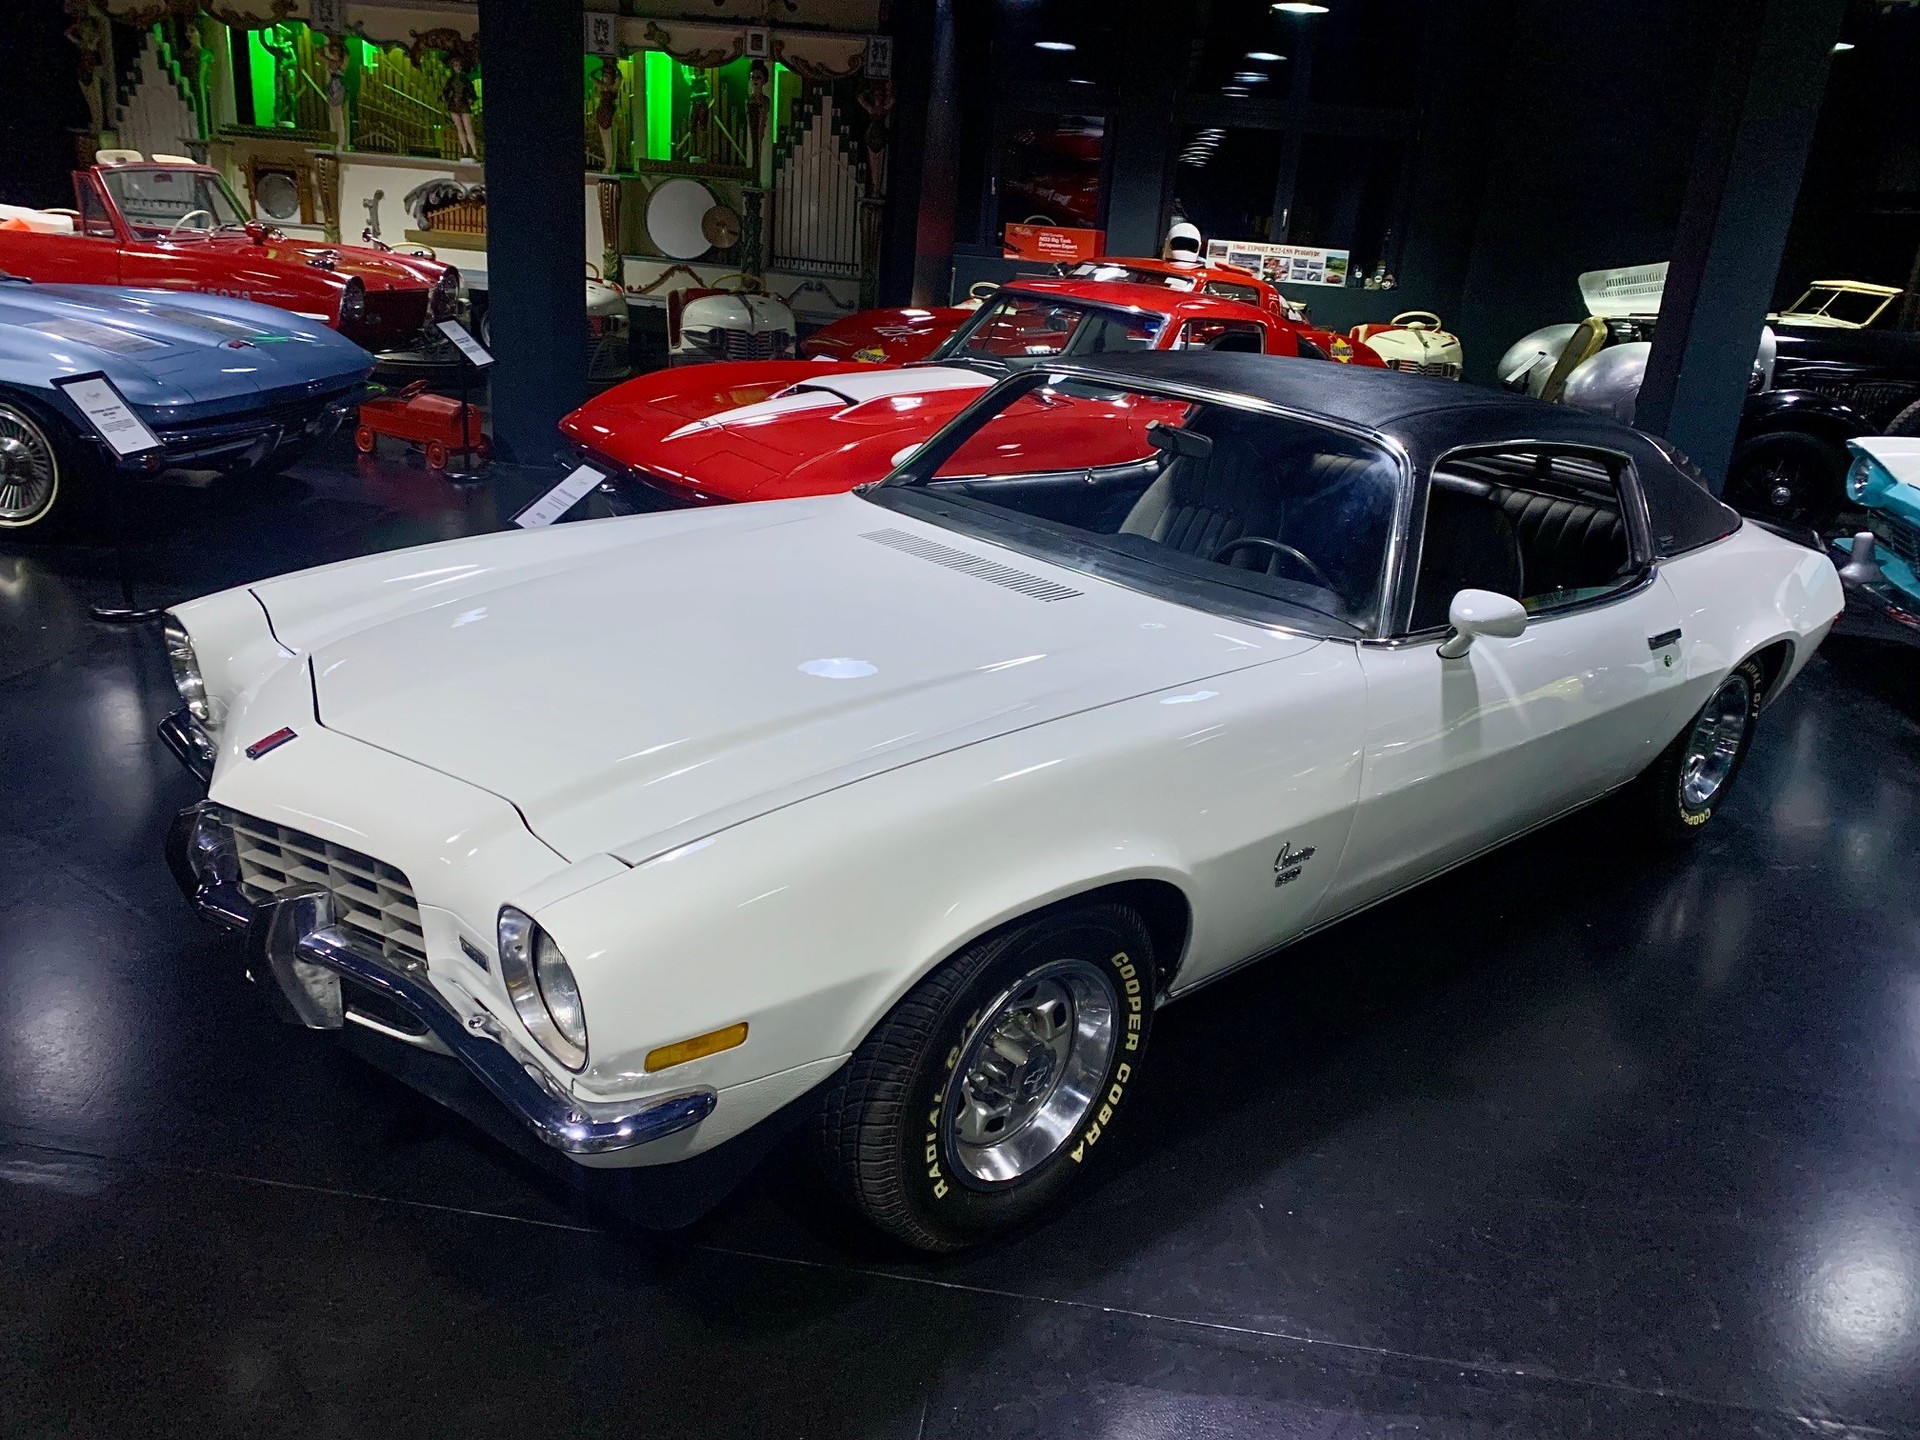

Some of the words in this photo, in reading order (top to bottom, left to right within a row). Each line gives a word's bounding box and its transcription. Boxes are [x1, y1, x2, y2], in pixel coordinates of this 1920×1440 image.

[1247, 245, 1269, 253] EXPORT
[1294, 248, 1321, 258] Prototype
[1111, 951, 1142, 1051] COOPER
[1070, 1062, 1132, 1164] COBRA
